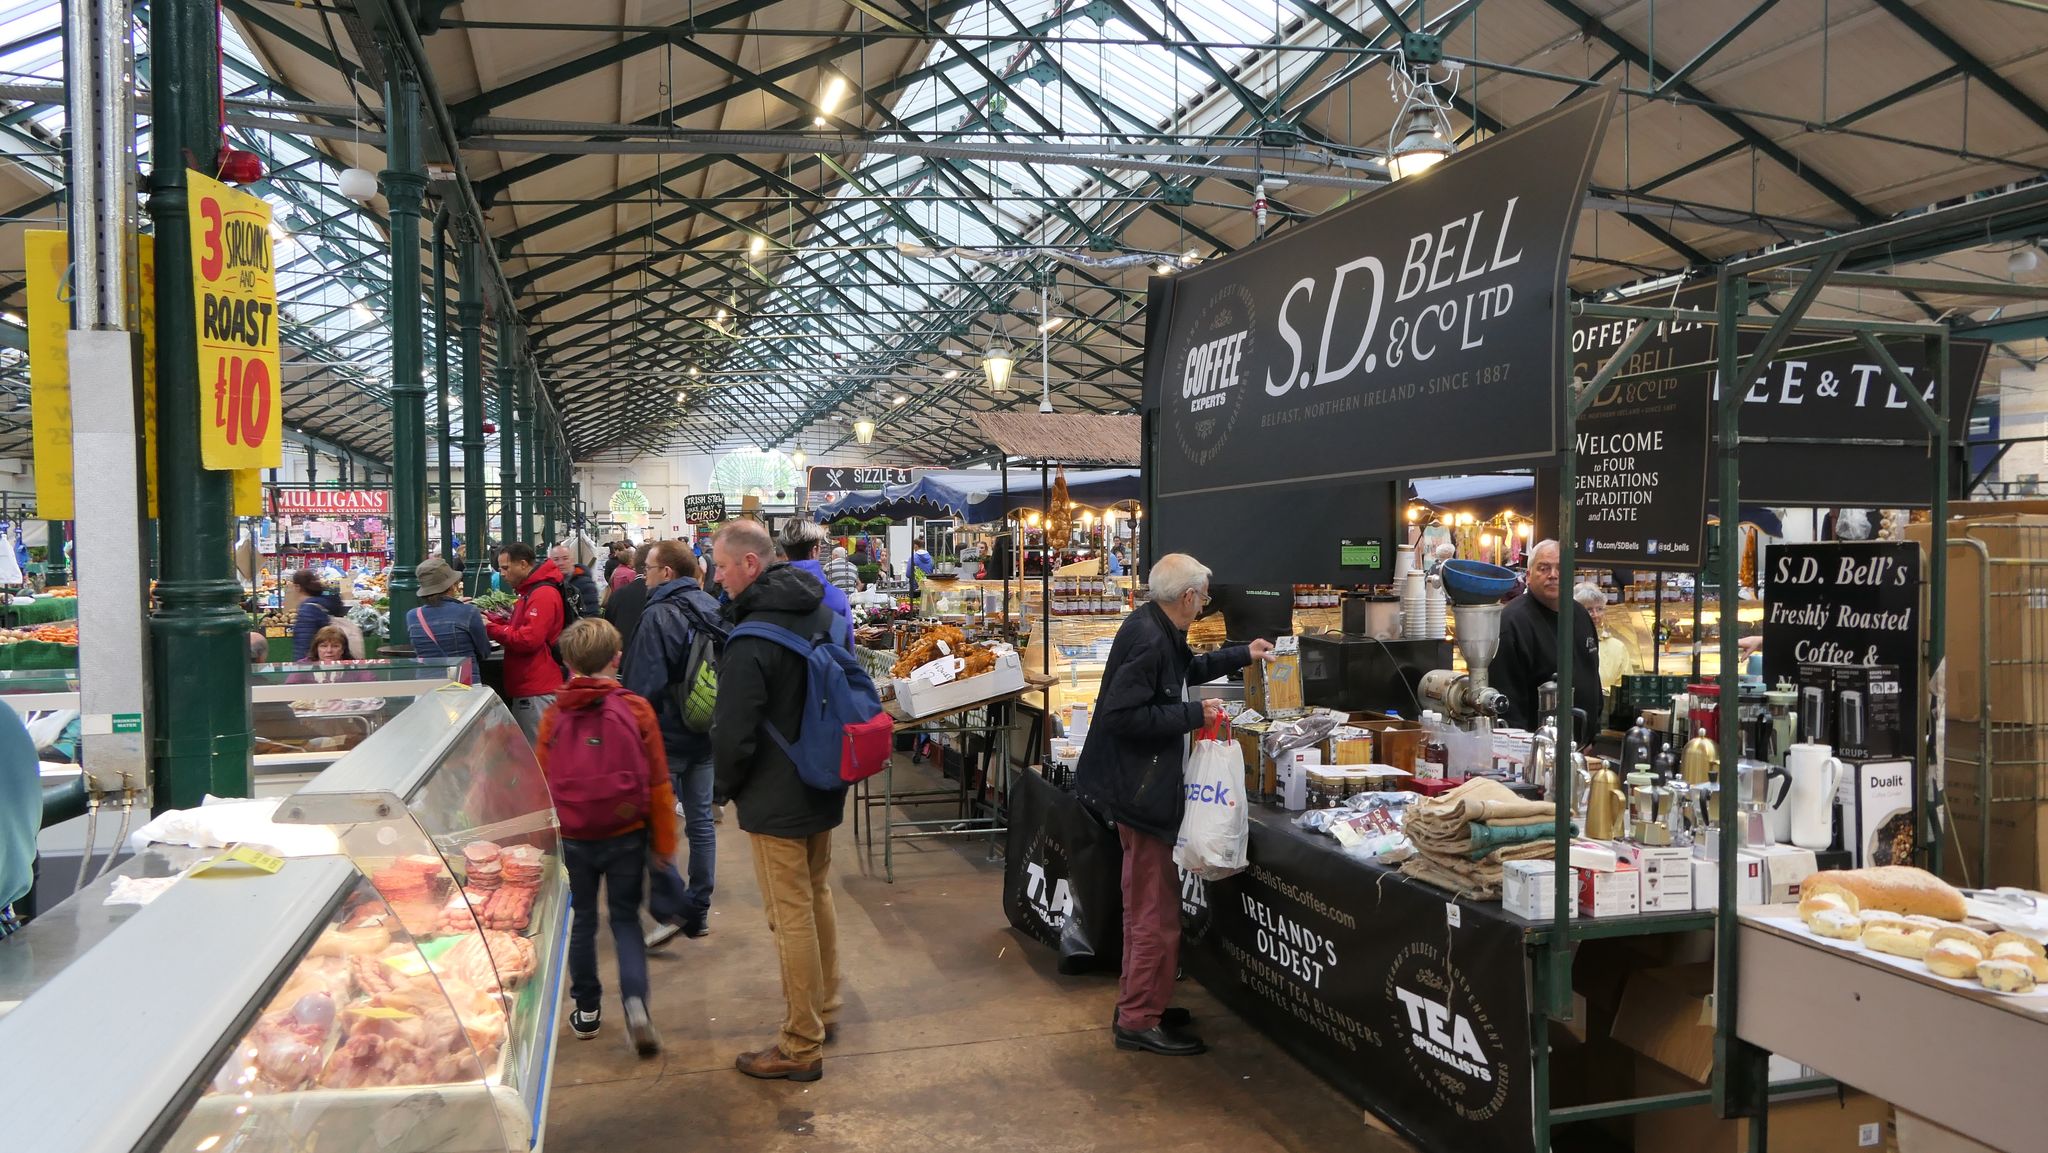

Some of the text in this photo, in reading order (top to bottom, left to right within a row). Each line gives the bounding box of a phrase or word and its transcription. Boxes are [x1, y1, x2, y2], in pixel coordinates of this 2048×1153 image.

[201, 197, 269, 282] 3 SIRLOINS
[240, 270, 255, 287] AND
[1264, 196, 1523, 397] S.D. BELL
[204, 292, 272, 346] ROAST
[1182, 329, 1248, 399] COFFEE
[1261, 362, 1512, 428] BELFAST, NORTHERN IRELAND SINCE 1887
[1816, 370, 1840, 397] &
[214, 356, 271, 448] £10
[1190, 391, 1227, 413] EXPERTS
[1575, 430, 1664, 456] WELCOME
[854, 468, 907, 483] SIZZLE &
[1594, 457, 1635, 472] to FOUR
[1575, 472, 1659, 489] GENERATIONS
[279, 490, 383, 507] MULLIGANS
[686, 494, 724, 505] IRISH STEW
[1576, 490, 1652, 506] of TRADITION
[691, 508, 721, 522] CURRY
[1588, 507, 1637, 521] and TASTE
[1596, 541, 1639, 550] fb.com/SDBells
[1658, 543, 1690, 552] @sd_bells
[1774, 556, 1908, 586] S.D. Bell's
[1769, 602, 1911, 632] Freshly Roasted
[1794, 639, 1879, 667] Coffee &
[1839, 747, 1869, 758] KRUPS
[1871, 775, 1903, 788] Dualit
[1241, 892, 1337, 966] IRELAND'S
[1257, 928, 1323, 989] OLDEST
[1222, 936, 1383, 1048] INDEPENDENT TEA BLENDERS
[1240, 968, 1357, 1052] & COFFEE ROASTERS
[1395, 985, 1489, 1065] TEA
[1411, 1033, 1492, 1082] SPECIALISTS
